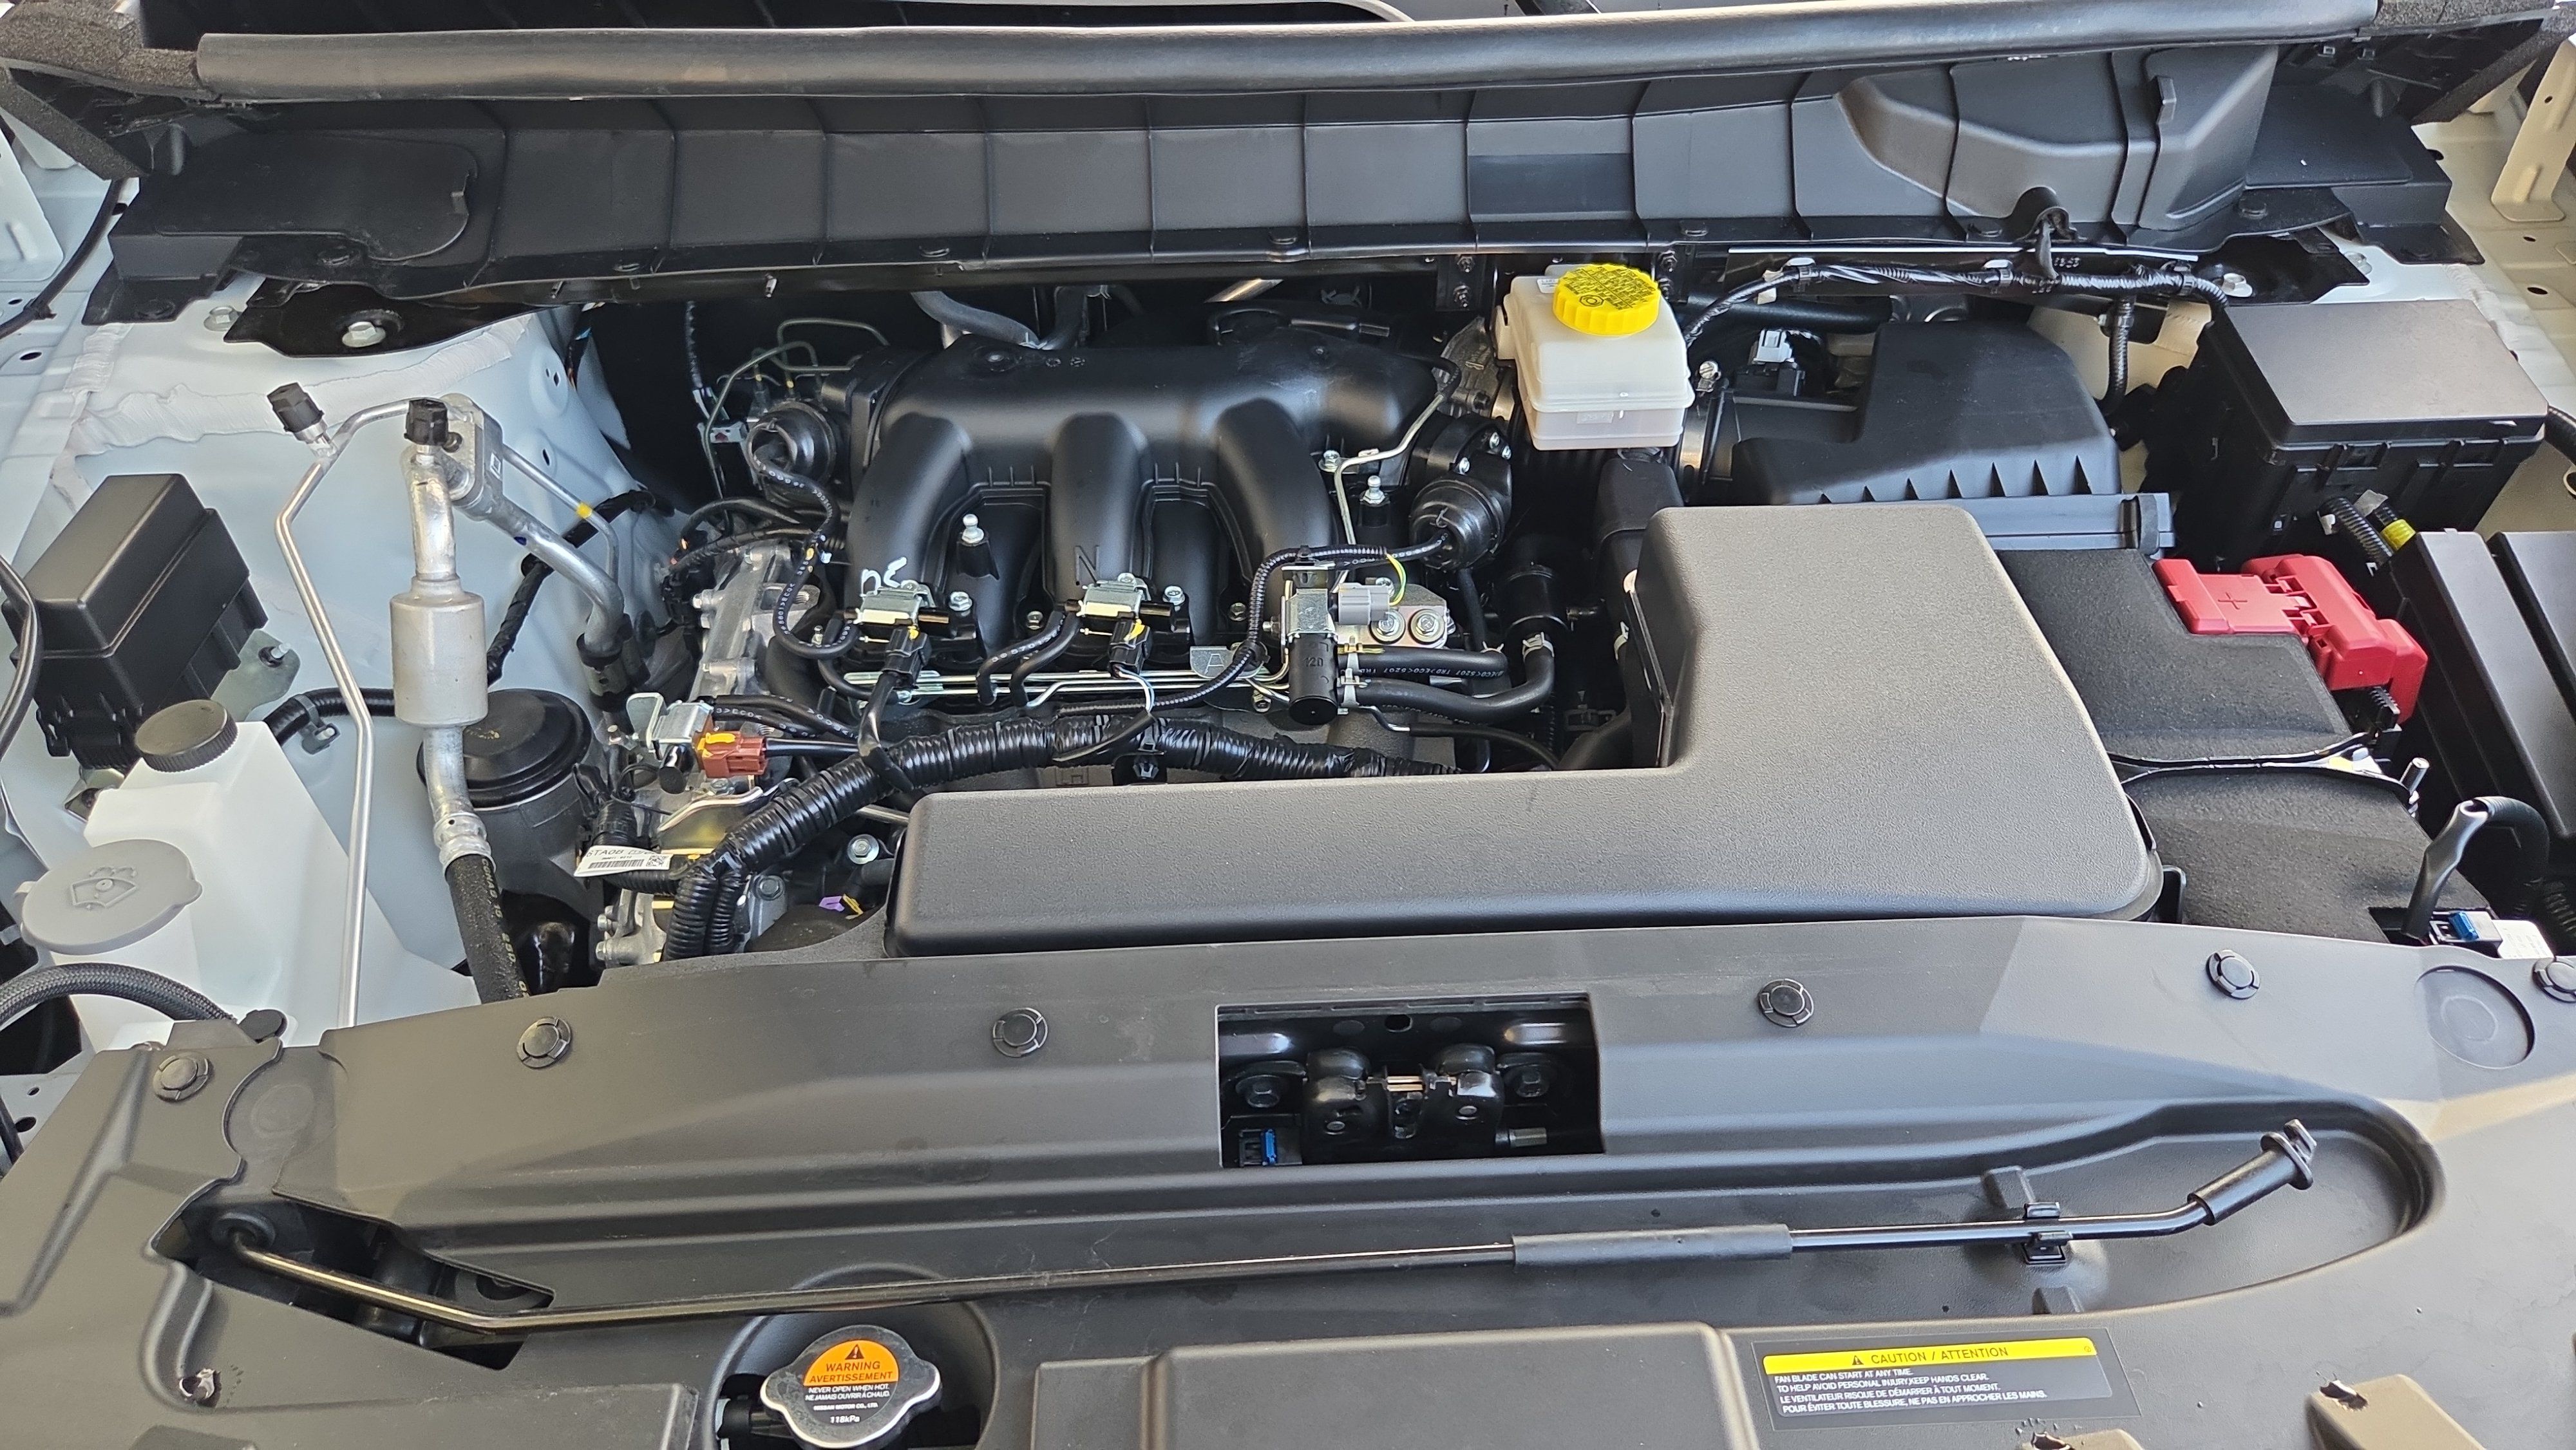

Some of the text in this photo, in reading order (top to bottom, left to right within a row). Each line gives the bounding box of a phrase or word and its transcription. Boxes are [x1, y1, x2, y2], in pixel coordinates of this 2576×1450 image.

[1871, 1351, 1927, 1364] CAUTION
[1941, 1347, 2009, 1360] ATTENTION
[826, 1361, 880, 1372] WARNING
[810, 1371, 893, 1382] AVERTISSEMENT
[1775, 1375, 1791, 1384] FAN
[1792, 1373, 1819, 1382] BLADE
[1819, 1372, 1837, 1381] CAN
[1838, 1371, 1862, 1379] START
[1875, 1369, 1891, 1377] ANY
[1893, 1368, 1914, 1377] TIME.
[1790, 1383, 1811, 1392] HELP
[1812, 1382, 1837, 1391] AVOID
[1838, 1379, 1882, 1389] PERSONAL
[1931, 1375, 1959, 1383] HANDS
[1960, 1373, 1989, 1382] CLEAR.
[1792, 1393, 1843, 1402] VENTILATEUR
[1844, 1390, 1875, 1400] RISQUE
[1889, 1386, 1932, 1397] DÉMARRER
[1940, 1386, 1962, 1394] TOUT
[1964, 1382, 2001, 1392] MOMENT.
[1783, 1404, 1807, 1413] POUR
[1808, 1402, 1835, 1411] ÉVITER
[1835, 1400, 1863, 1410] TOUTE
[1864, 1398, 1908, 1409] BLESSURE,
[1938, 1396, 1951, 1404] EN
[1952, 1393, 2002, 1404] APPROCHER
[2002, 1391, 2018, 1400] LES
[2020, 1389, 2047, 1398] MAINS.
[830, 1415, 860, 1424] 118kPa
